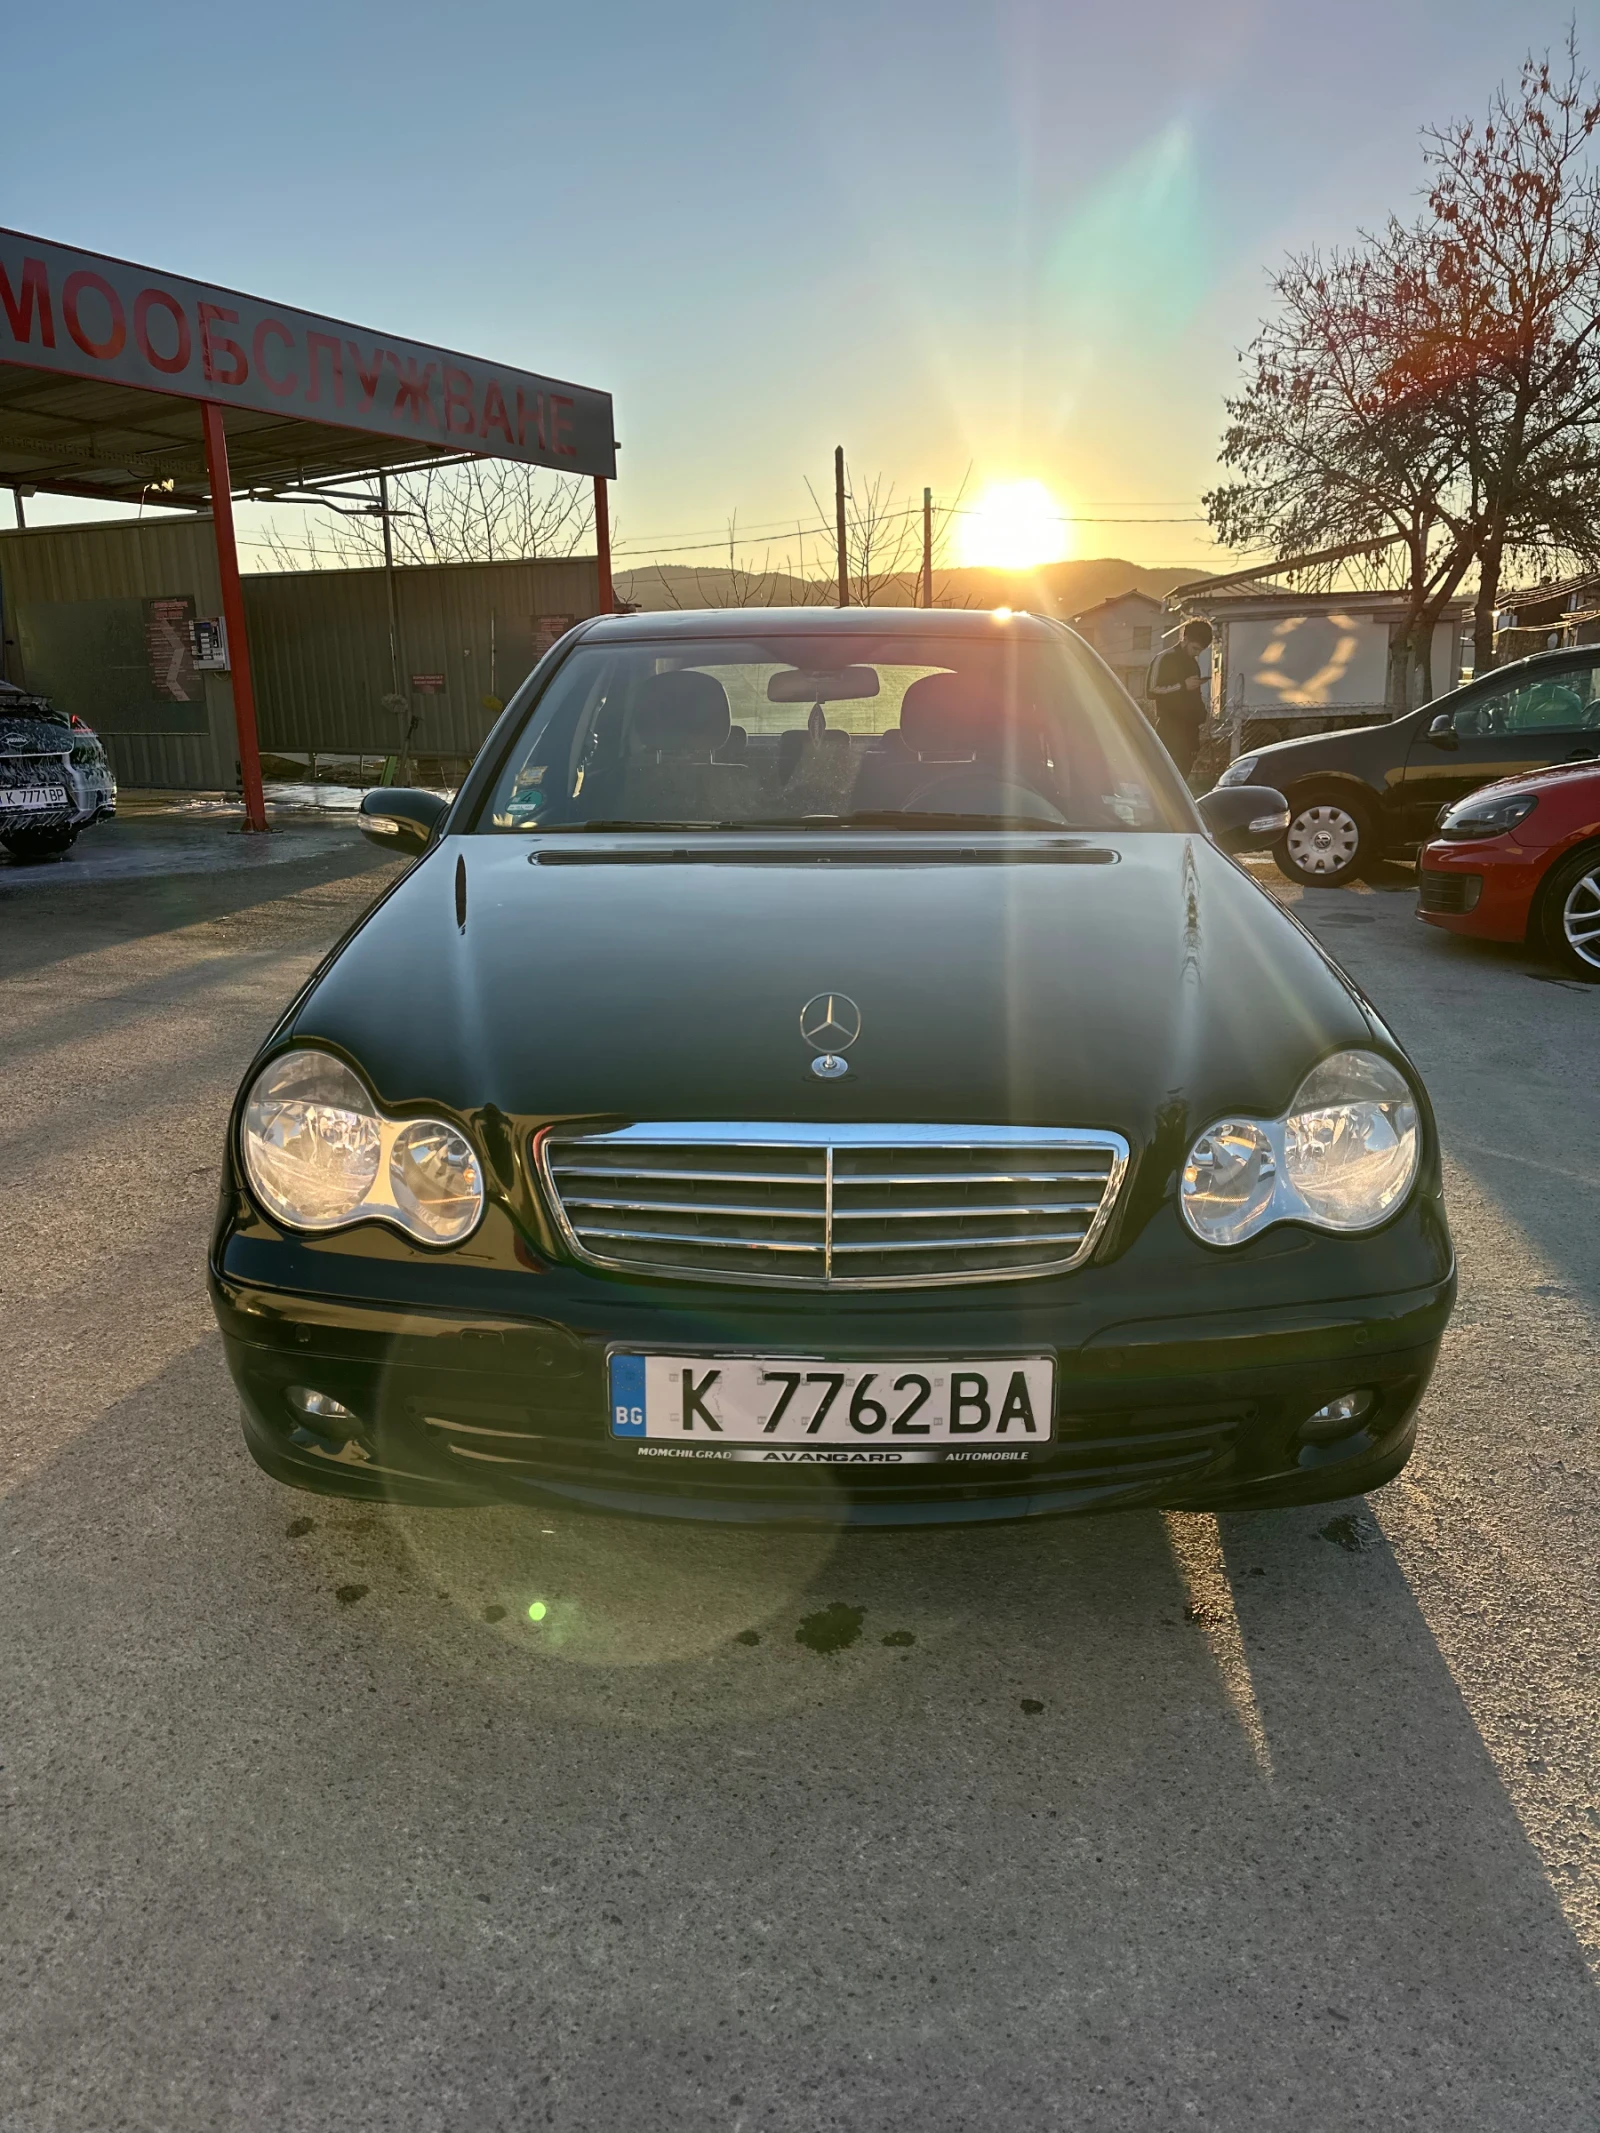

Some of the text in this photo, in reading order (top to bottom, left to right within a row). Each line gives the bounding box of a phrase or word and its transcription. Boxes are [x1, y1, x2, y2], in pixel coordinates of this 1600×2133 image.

[6, 792, 15, 804] K
[520, 792, 533, 803] 4
[682, 1368, 724, 1432] K
[615, 1407, 643, 1425] BG
[637, 1447, 1029, 1462] MOMCHILGRAD AVANGARD AUTOMOBILE
